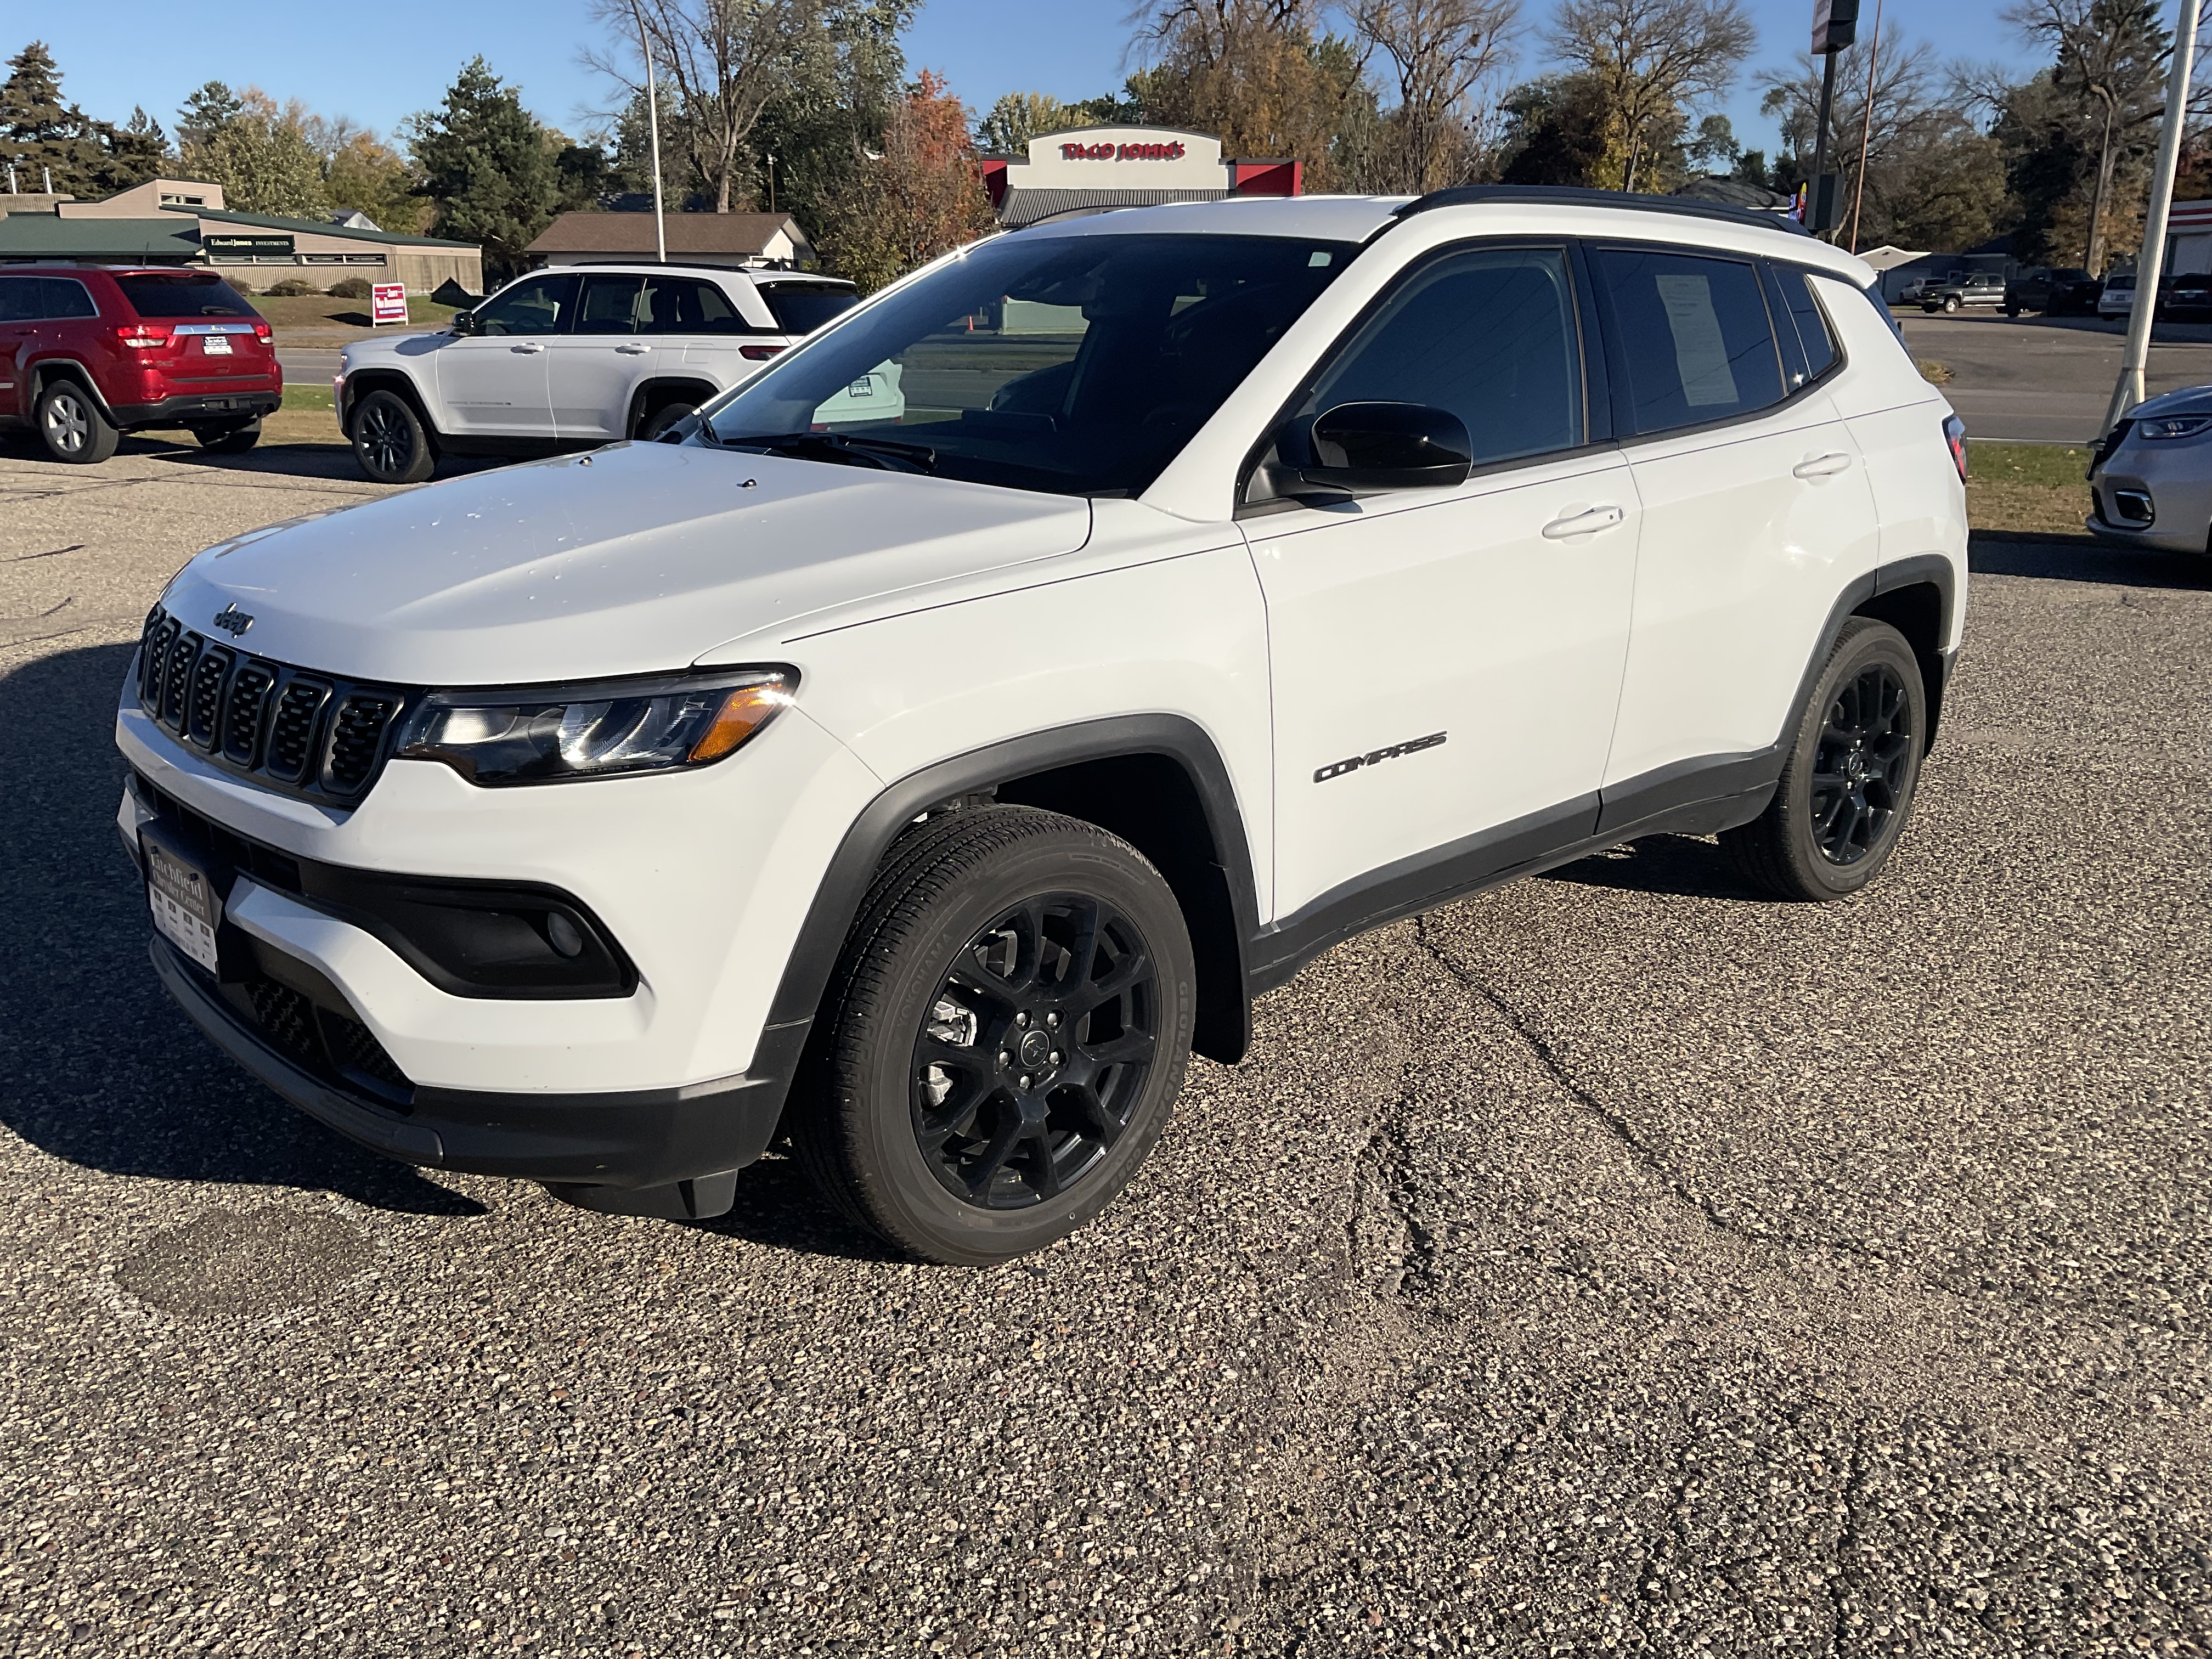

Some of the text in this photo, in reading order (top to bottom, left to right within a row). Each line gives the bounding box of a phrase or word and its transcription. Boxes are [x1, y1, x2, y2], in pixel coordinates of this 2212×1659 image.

[1061, 141, 1186, 161] TACO JOHN'S
[213, 602, 255, 639] Jeep
[1312, 730, 1447, 783] COMPASS
[151, 854, 202, 900] Litchfield
[153, 868, 179, 899] Chrysler
[180, 889, 205, 916] Center
[896, 933, 954, 1027] YOKOHAMA
[1147, 980, 1189, 1138] GEOLANDAR
